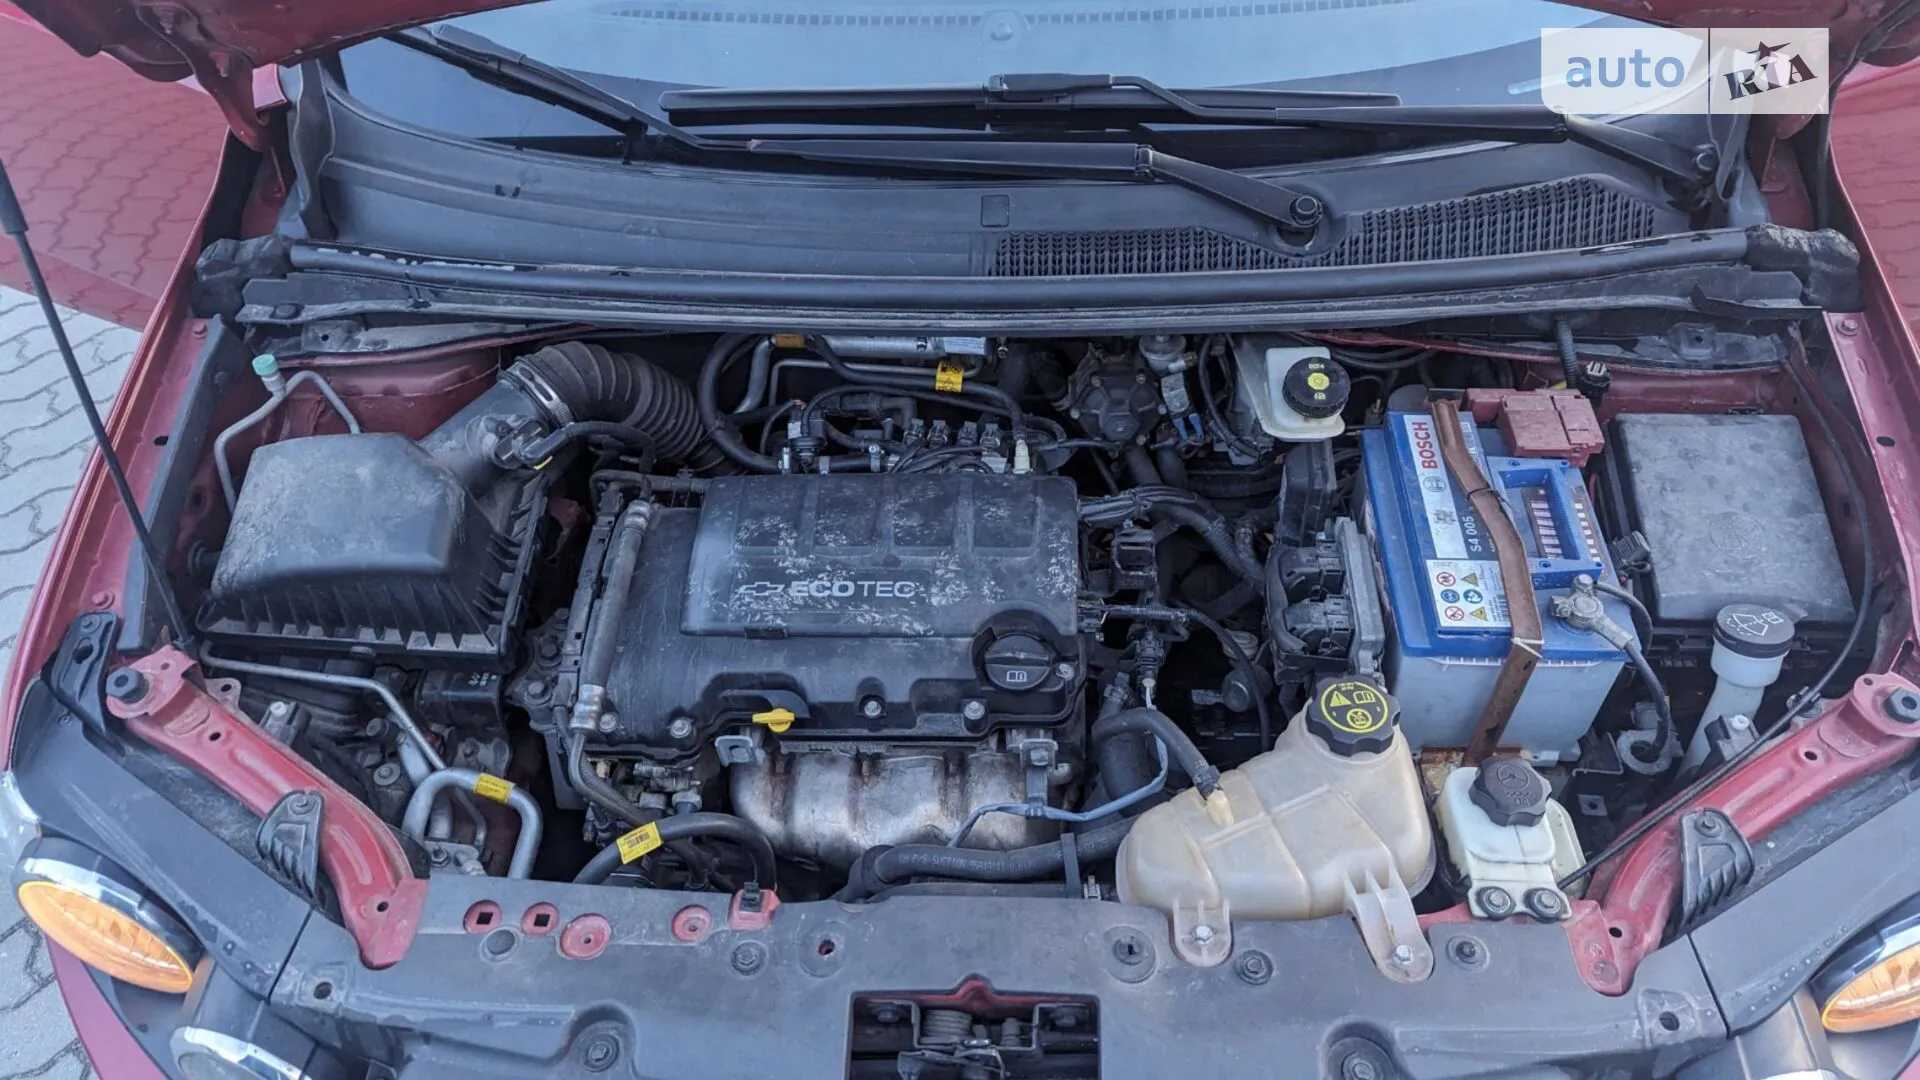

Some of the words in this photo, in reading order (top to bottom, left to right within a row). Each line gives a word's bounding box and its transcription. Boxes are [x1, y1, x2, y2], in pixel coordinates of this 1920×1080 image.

[1411, 421, 1439, 469] BOSCH
[1462, 516, 1478, 536] 005
[1467, 538, 1482, 552] S4
[790, 580, 917, 598] ECOTEC
